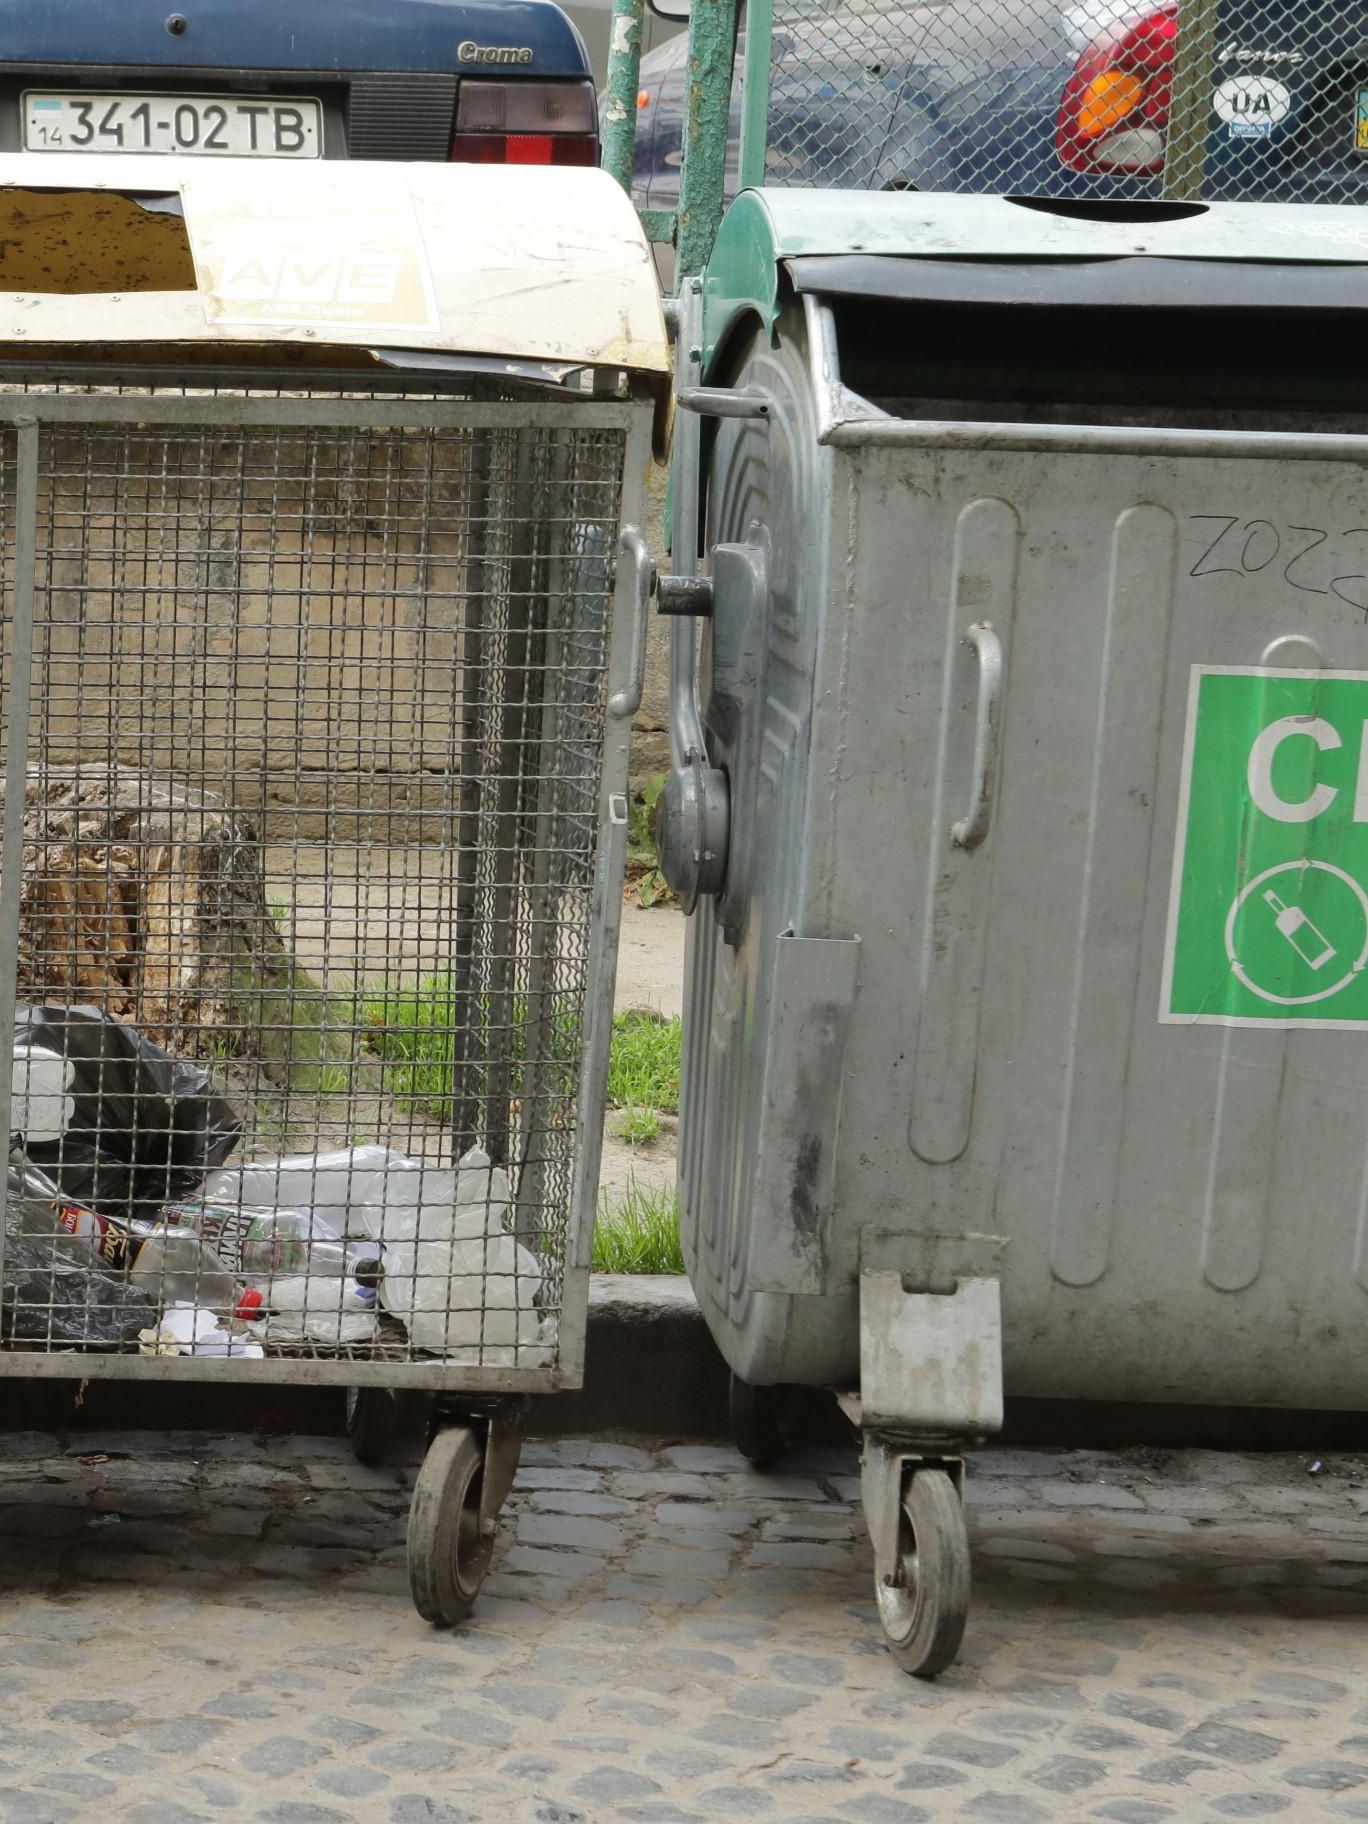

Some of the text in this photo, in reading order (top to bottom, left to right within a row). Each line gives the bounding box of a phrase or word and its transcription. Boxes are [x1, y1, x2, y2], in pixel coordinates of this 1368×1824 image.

[458, 41, 534, 64] Croma
[1232, 92, 1272, 114] UA
[38, 126, 63, 146] 14
[229, 260, 394, 288] AVE
[1247, 714, 1368, 824] С
